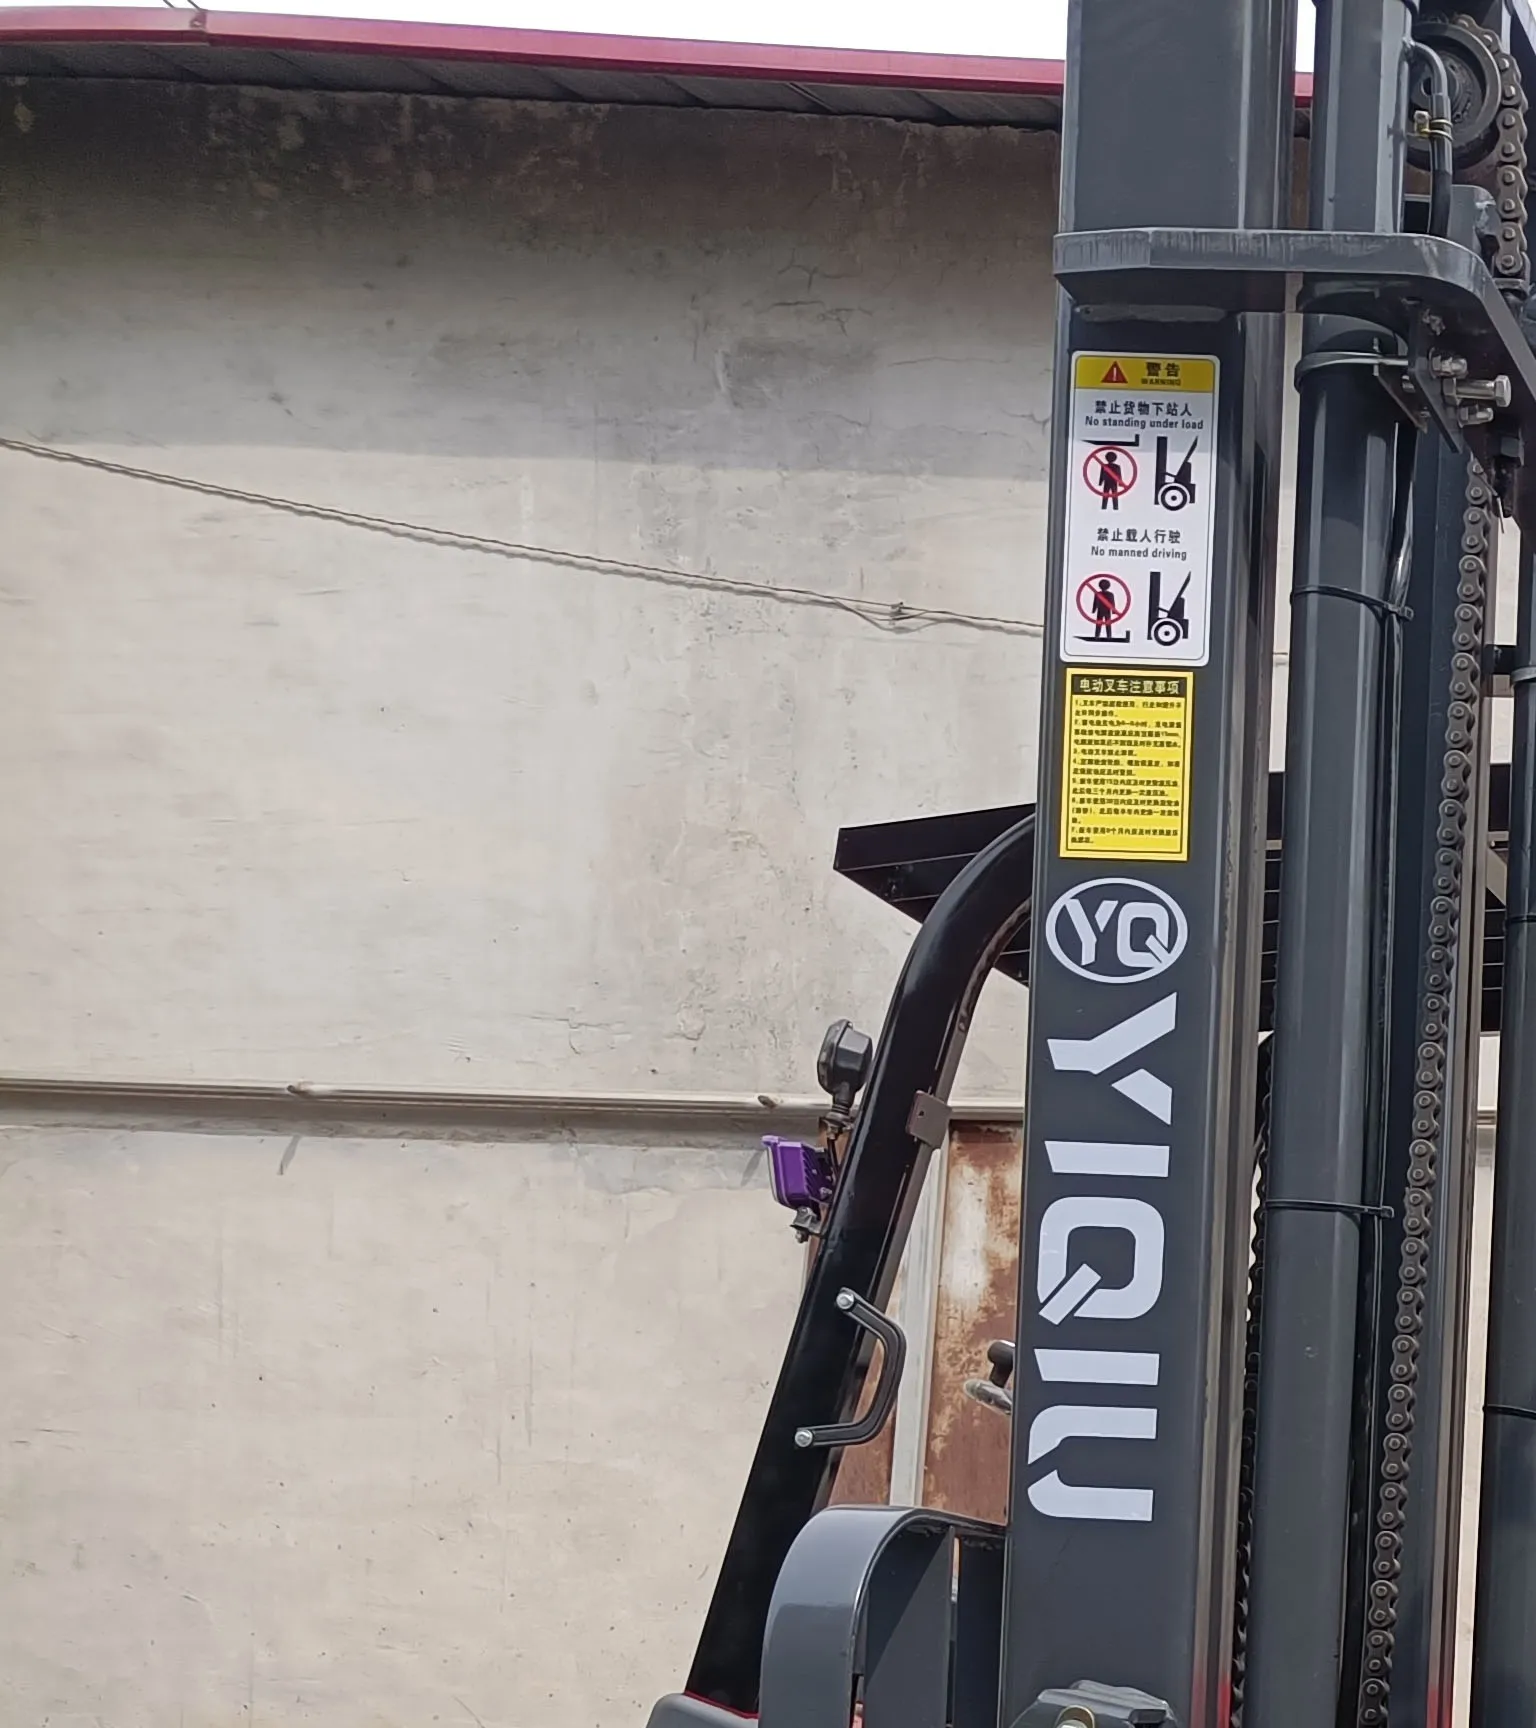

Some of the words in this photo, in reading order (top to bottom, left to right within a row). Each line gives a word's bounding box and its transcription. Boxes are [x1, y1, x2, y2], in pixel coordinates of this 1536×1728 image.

[1145, 362, 1181, 377] 警告
[1094, 400, 1193, 418] 禁止货物下站人
[1085, 416, 1100, 427] No
[1102, 416, 1147, 430] standing
[1150, 418, 1179, 429] under
[1181, 418, 1204, 430] load
[1096, 527, 1182, 545] 禁止载人行驶
[1091, 545, 1105, 557] No
[1107, 546, 1149, 559] manned
[1151, 547, 1187, 561] driving
[1079, 677, 1180, 695] 电动叉车注意事项
[1063, 898, 1172, 970] YQ
[1027, 991, 1178, 1523] YIQIU
